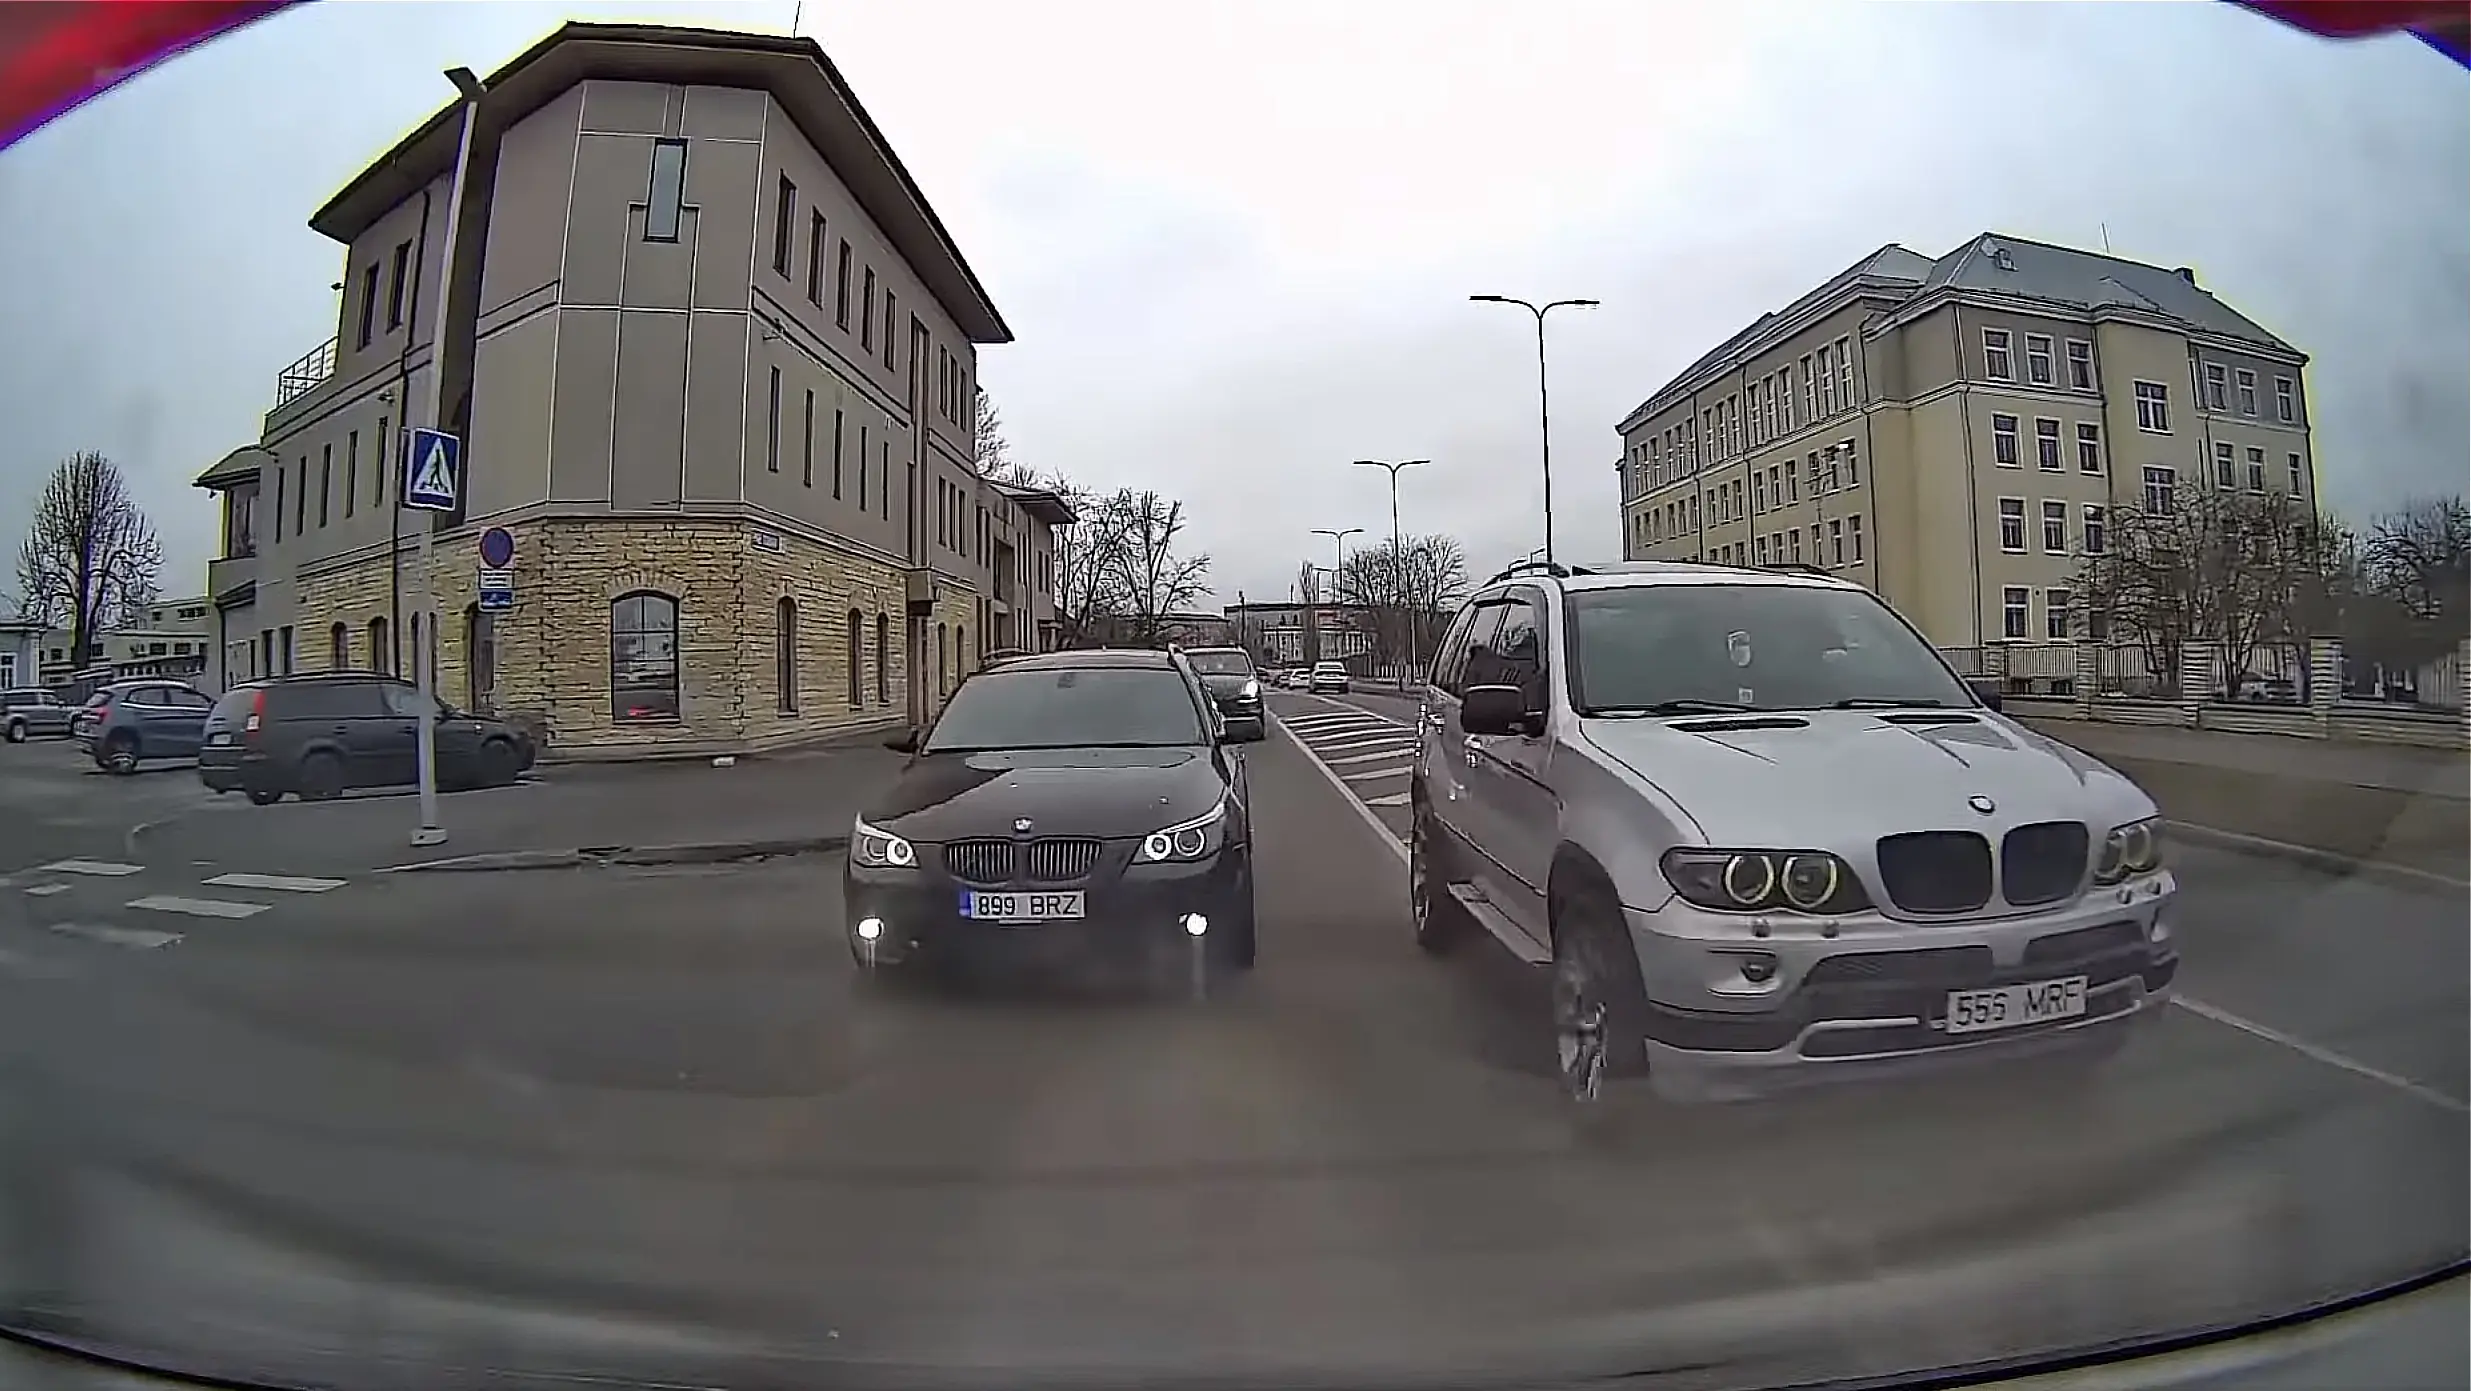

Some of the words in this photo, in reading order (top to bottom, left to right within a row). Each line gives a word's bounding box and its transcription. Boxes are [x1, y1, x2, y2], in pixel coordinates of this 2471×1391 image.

[978, 895, 1016, 916] 899
[1030, 895, 1078, 915] BRZ
[2024, 980, 2080, 1018] MRF
